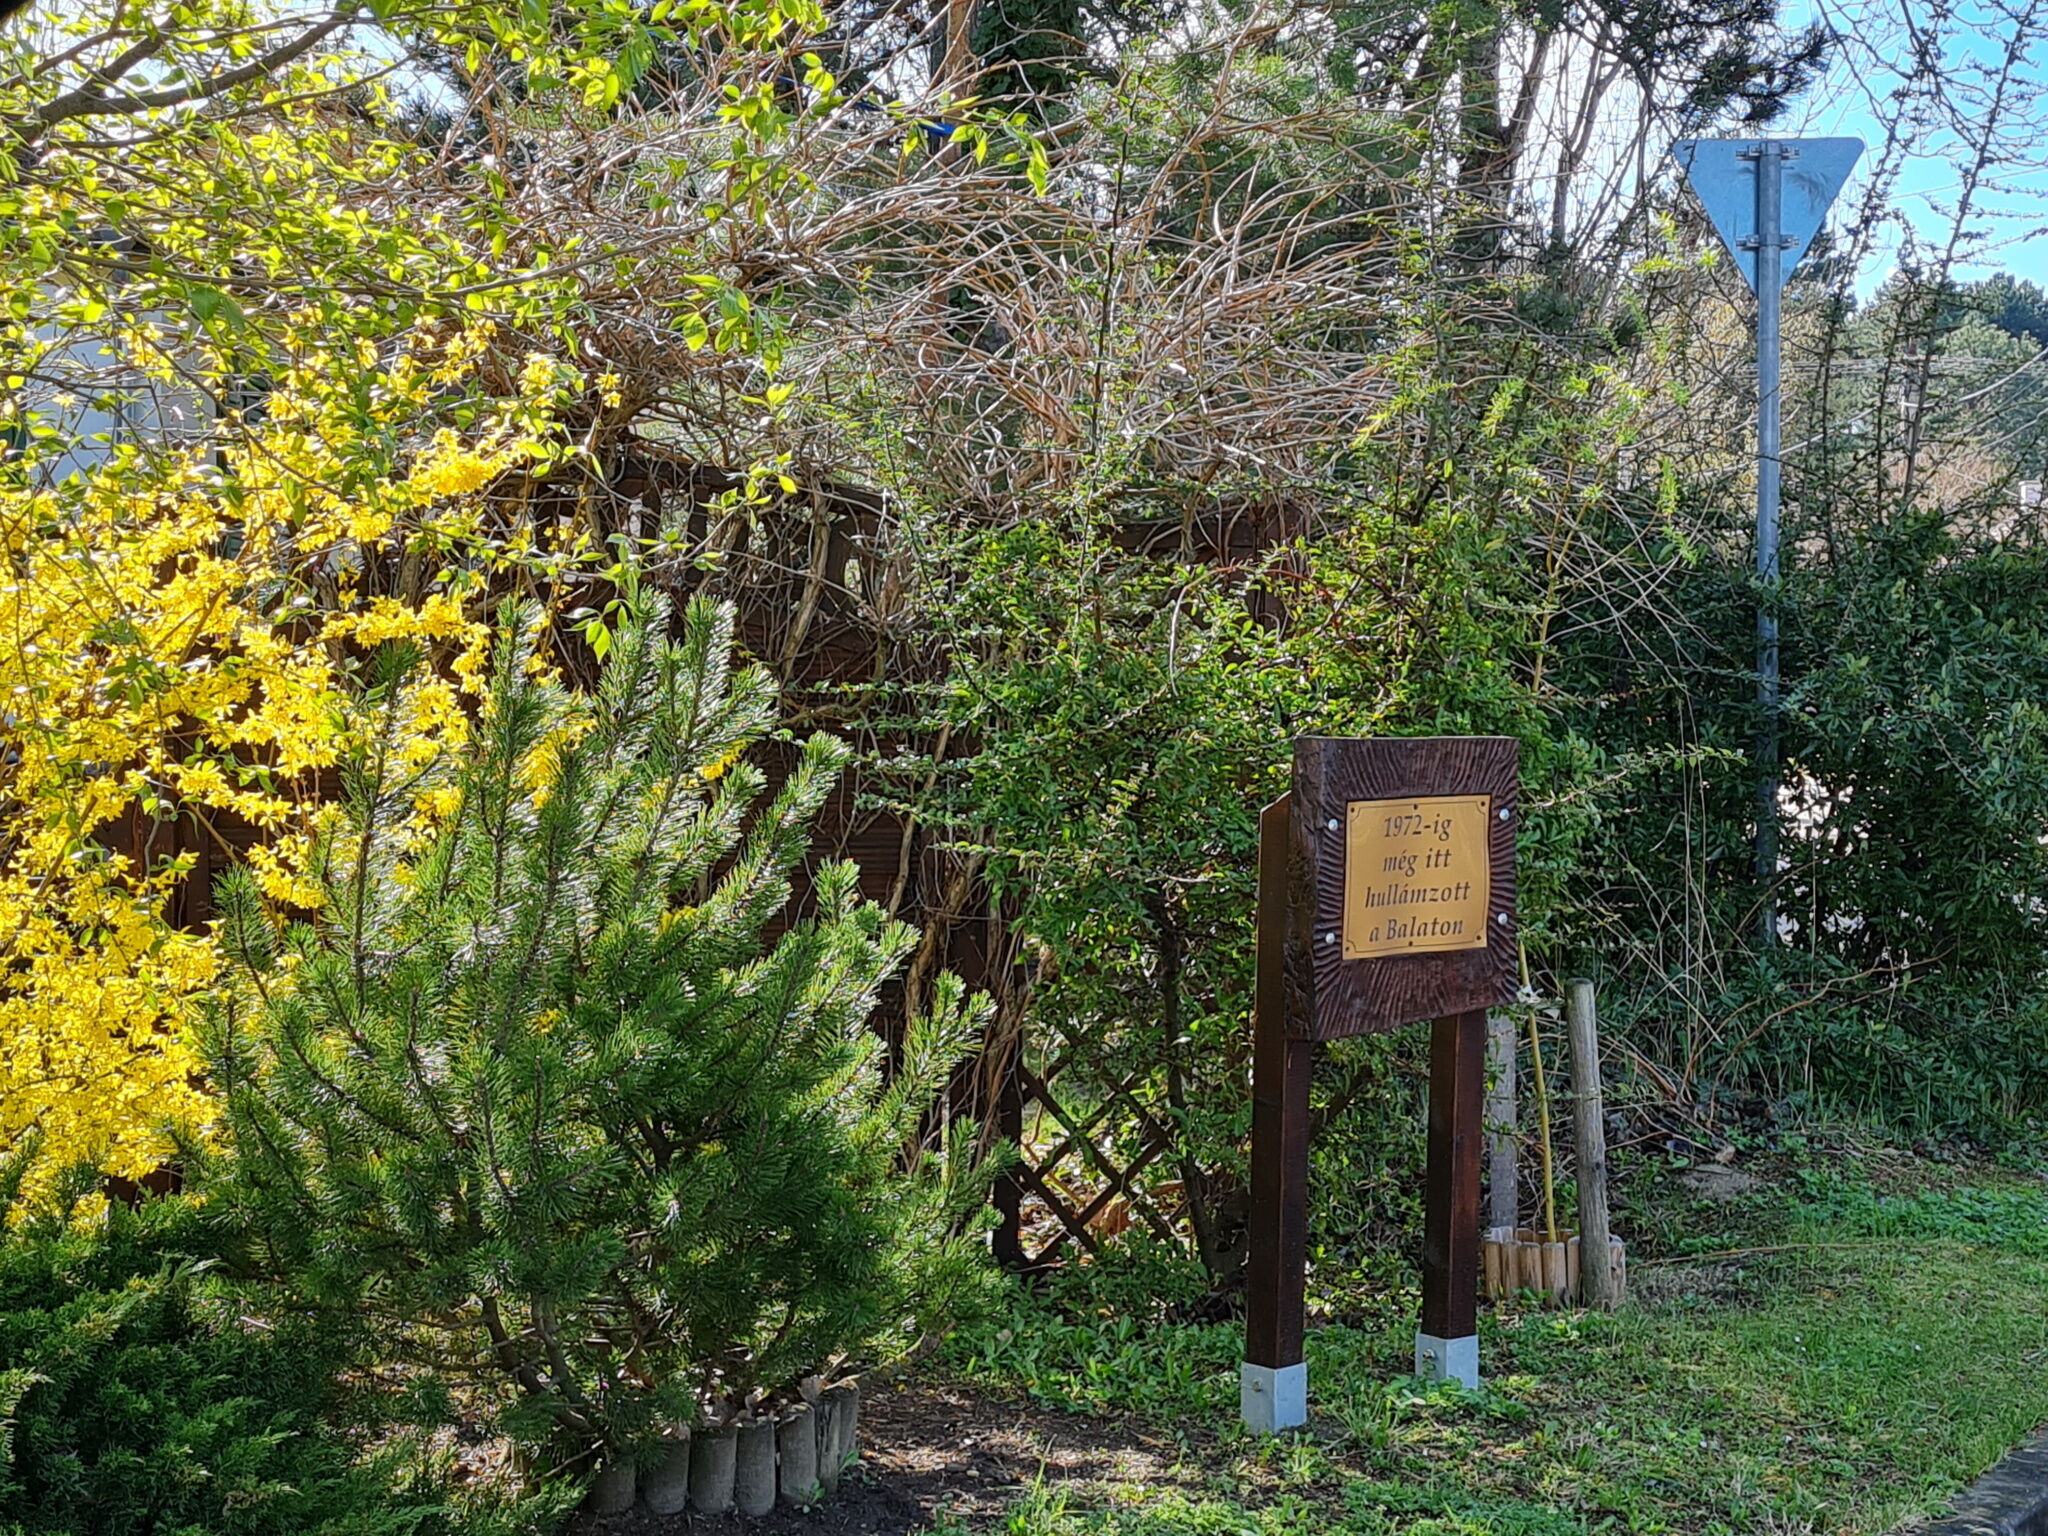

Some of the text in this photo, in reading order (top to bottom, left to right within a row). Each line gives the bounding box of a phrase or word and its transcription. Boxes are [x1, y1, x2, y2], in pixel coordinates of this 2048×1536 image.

[1384, 813, 1452, 841] 1972-ig
[1383, 848, 1452, 877] még itt
[1365, 881, 1471, 908] hullámzott
[1369, 916, 1463, 942] a Balaton
